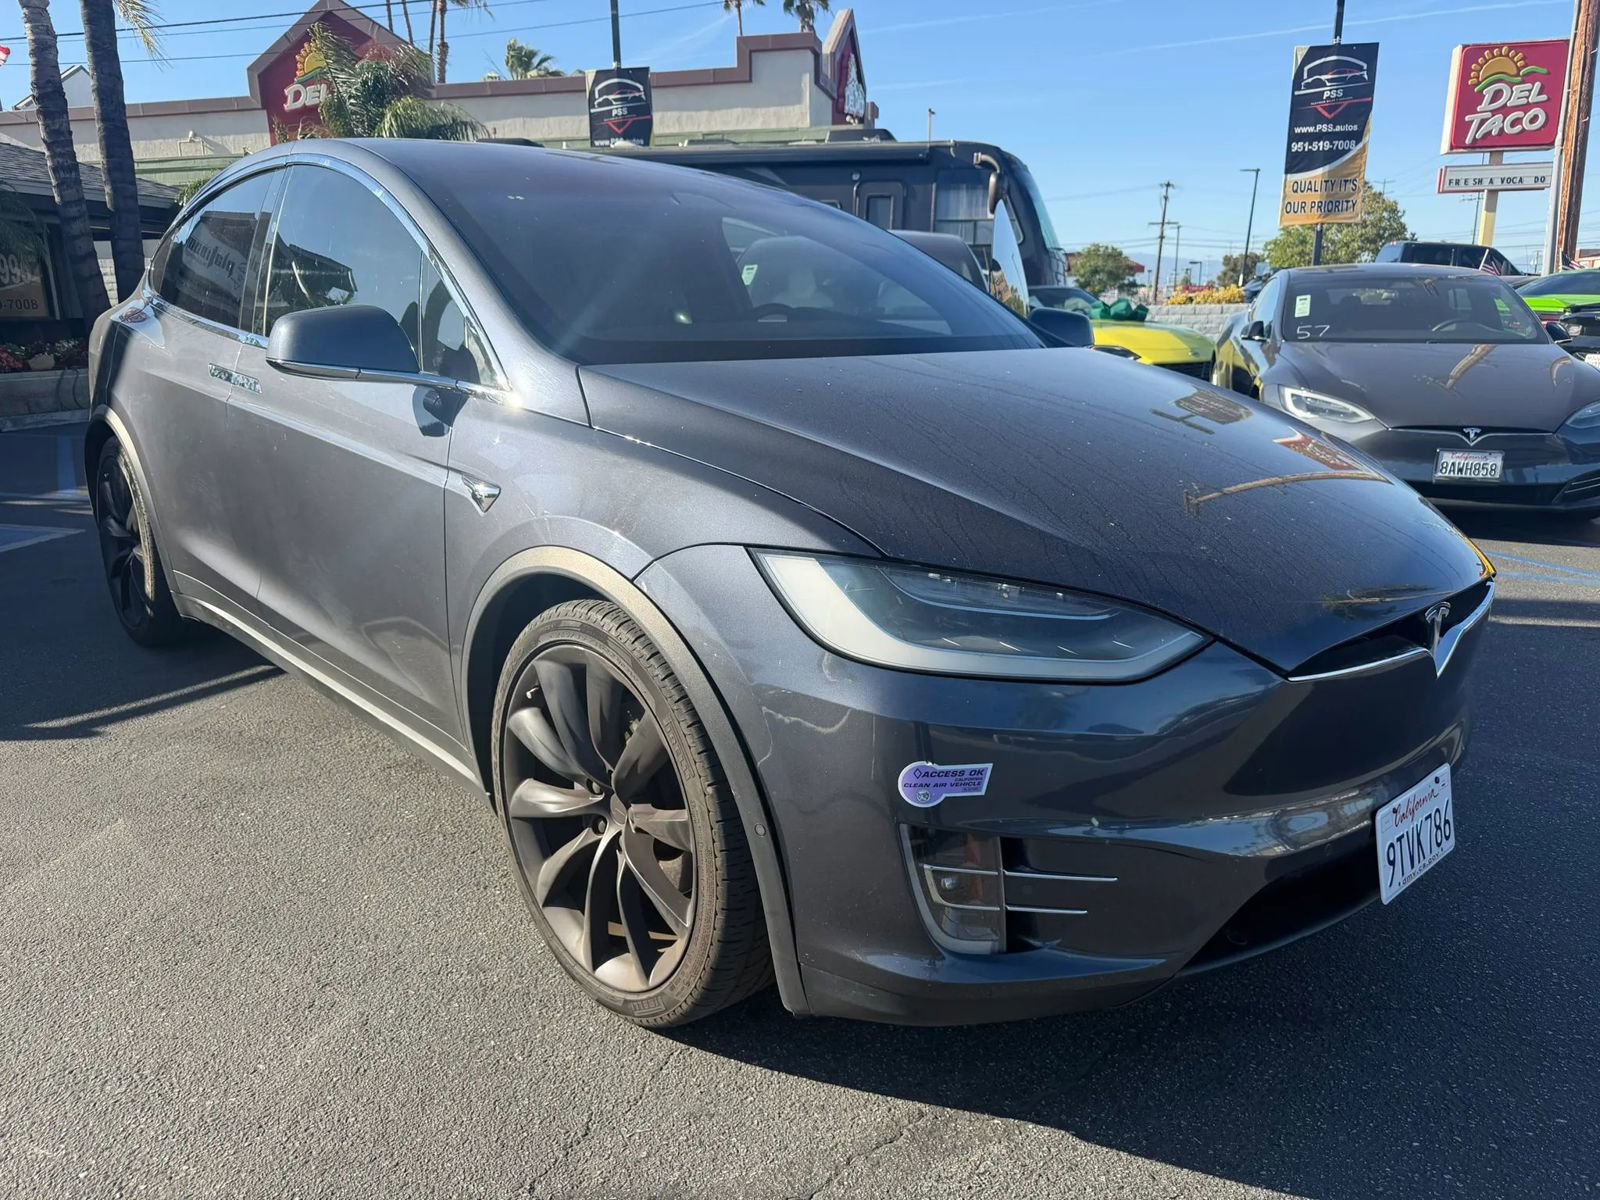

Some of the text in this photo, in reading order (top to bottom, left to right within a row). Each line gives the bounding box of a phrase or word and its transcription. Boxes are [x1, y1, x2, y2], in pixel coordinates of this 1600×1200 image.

[1323, 89, 1344, 100] PSS
[1477, 81, 1548, 112] DEL
[612, 107, 628, 117] PSS
[1294, 123, 1359, 134] www.PSS.autos
[1465, 107, 1546, 144] TACO
[1291, 140, 1356, 153] 951-519-7008
[1292, 178, 1358, 194] QUALITY IT'S
[1285, 199, 1358, 214] OUR PRIORITY
[1297, 325, 1330, 339] 57
[1440, 461, 1497, 476] 8AWH858
[921, 768, 984, 778] ACCESS OK
[1392, 788, 1439, 827] California
[1386, 799, 1452, 888] 9TVK786
